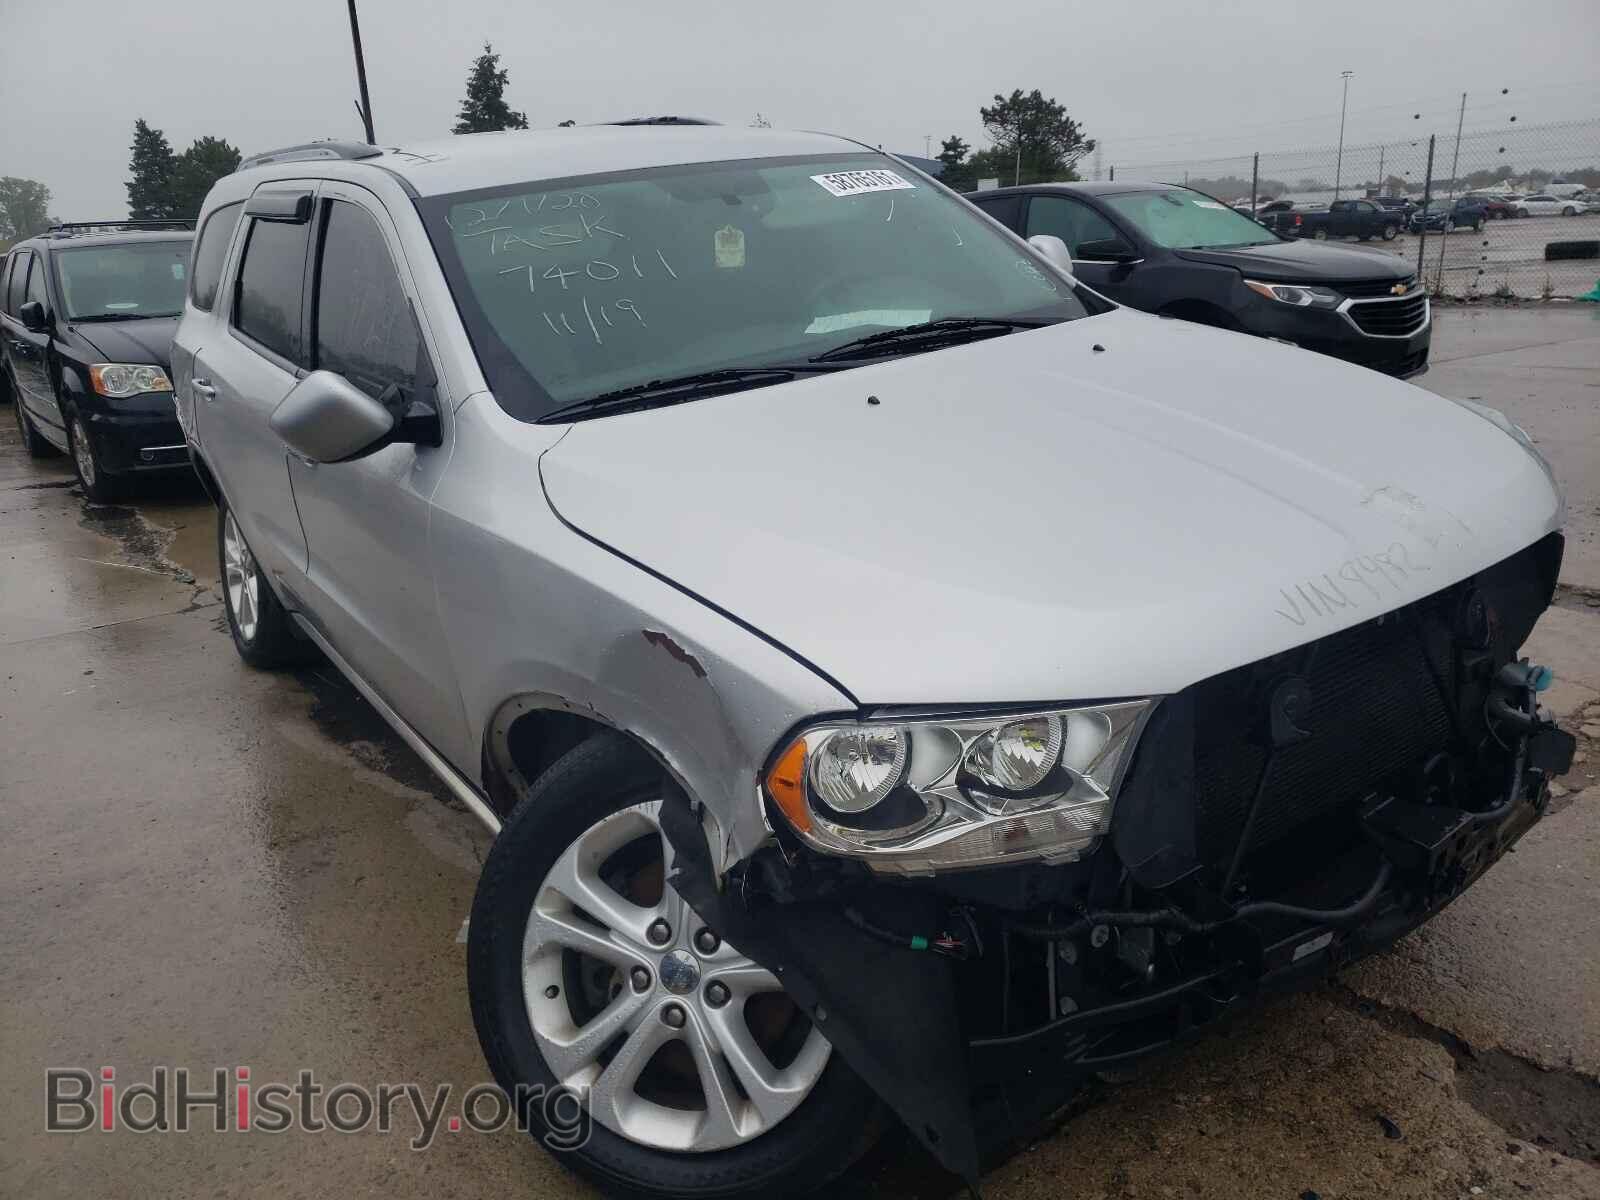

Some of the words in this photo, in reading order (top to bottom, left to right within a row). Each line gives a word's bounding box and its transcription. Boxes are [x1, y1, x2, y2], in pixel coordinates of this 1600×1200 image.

[463, 214, 630, 256] TASK
[498, 249, 678, 292] 74011
[543, 296, 647, 344] 11/19
[1274, 574, 1359, 626] VIN
